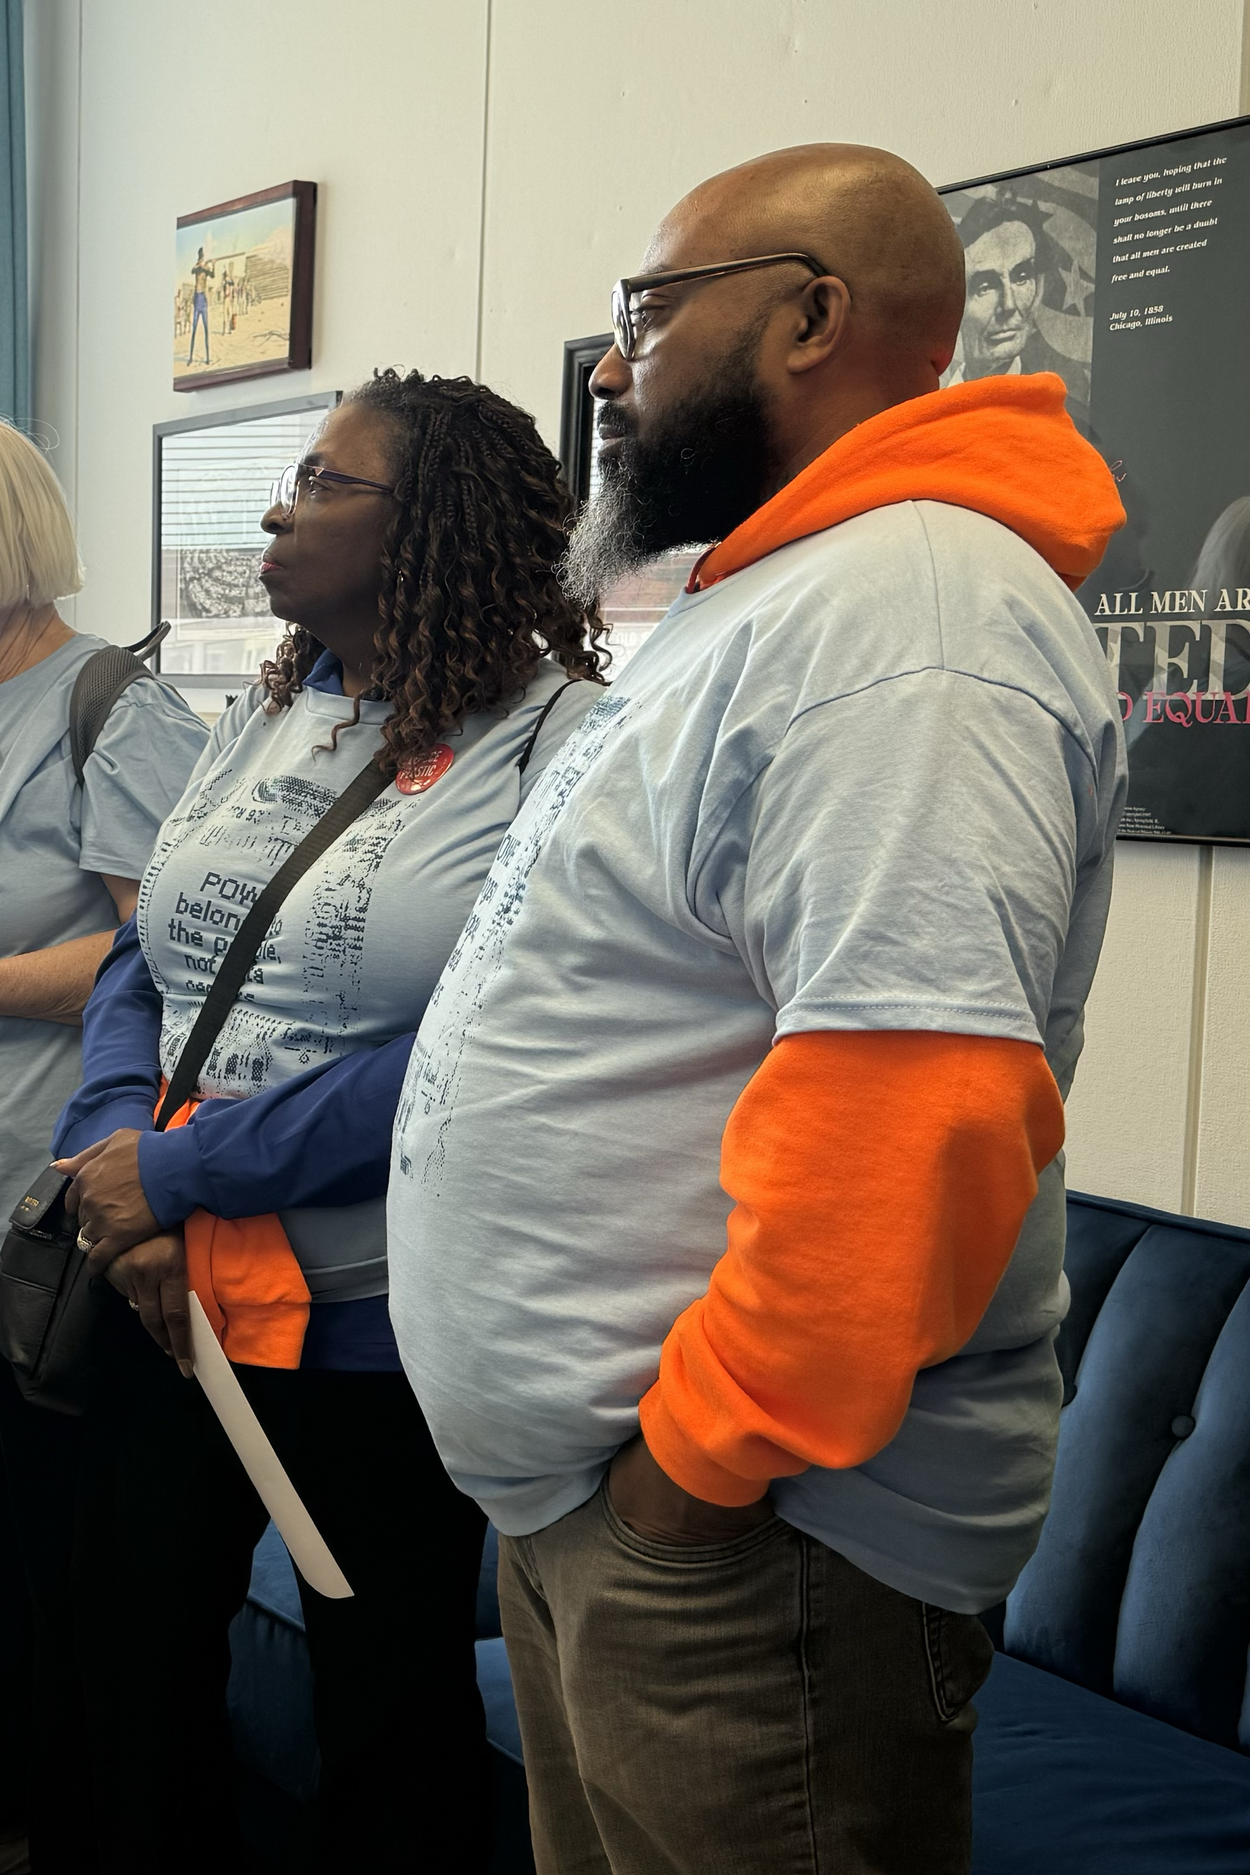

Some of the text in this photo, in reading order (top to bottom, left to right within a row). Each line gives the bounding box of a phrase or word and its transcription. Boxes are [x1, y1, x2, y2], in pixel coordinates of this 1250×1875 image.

[1115, 157, 1227, 187] I leave you, hoping that the
[1114, 177, 1223, 206] lamp of liberty will burn in
[1113, 200, 1213, 227] your bosoms, until there
[1112, 233, 1133, 244] shall
[1146, 227, 1173, 238] longer
[1174, 225, 1185, 233] be
[1193, 217, 1218, 229] doubt
[1112, 238, 1208, 263] that all men are created
[1111, 265, 1170, 284] free and equal.
[1109, 305, 1164, 321] July 10, 1858
[1109, 314, 1173, 331] Chicago, Illinois
[1094, 592, 1143, 616] ALL
[1150, 589, 1209, 614] MEN
[168, 918, 203, 947] the
[184, 955, 217, 975] not
